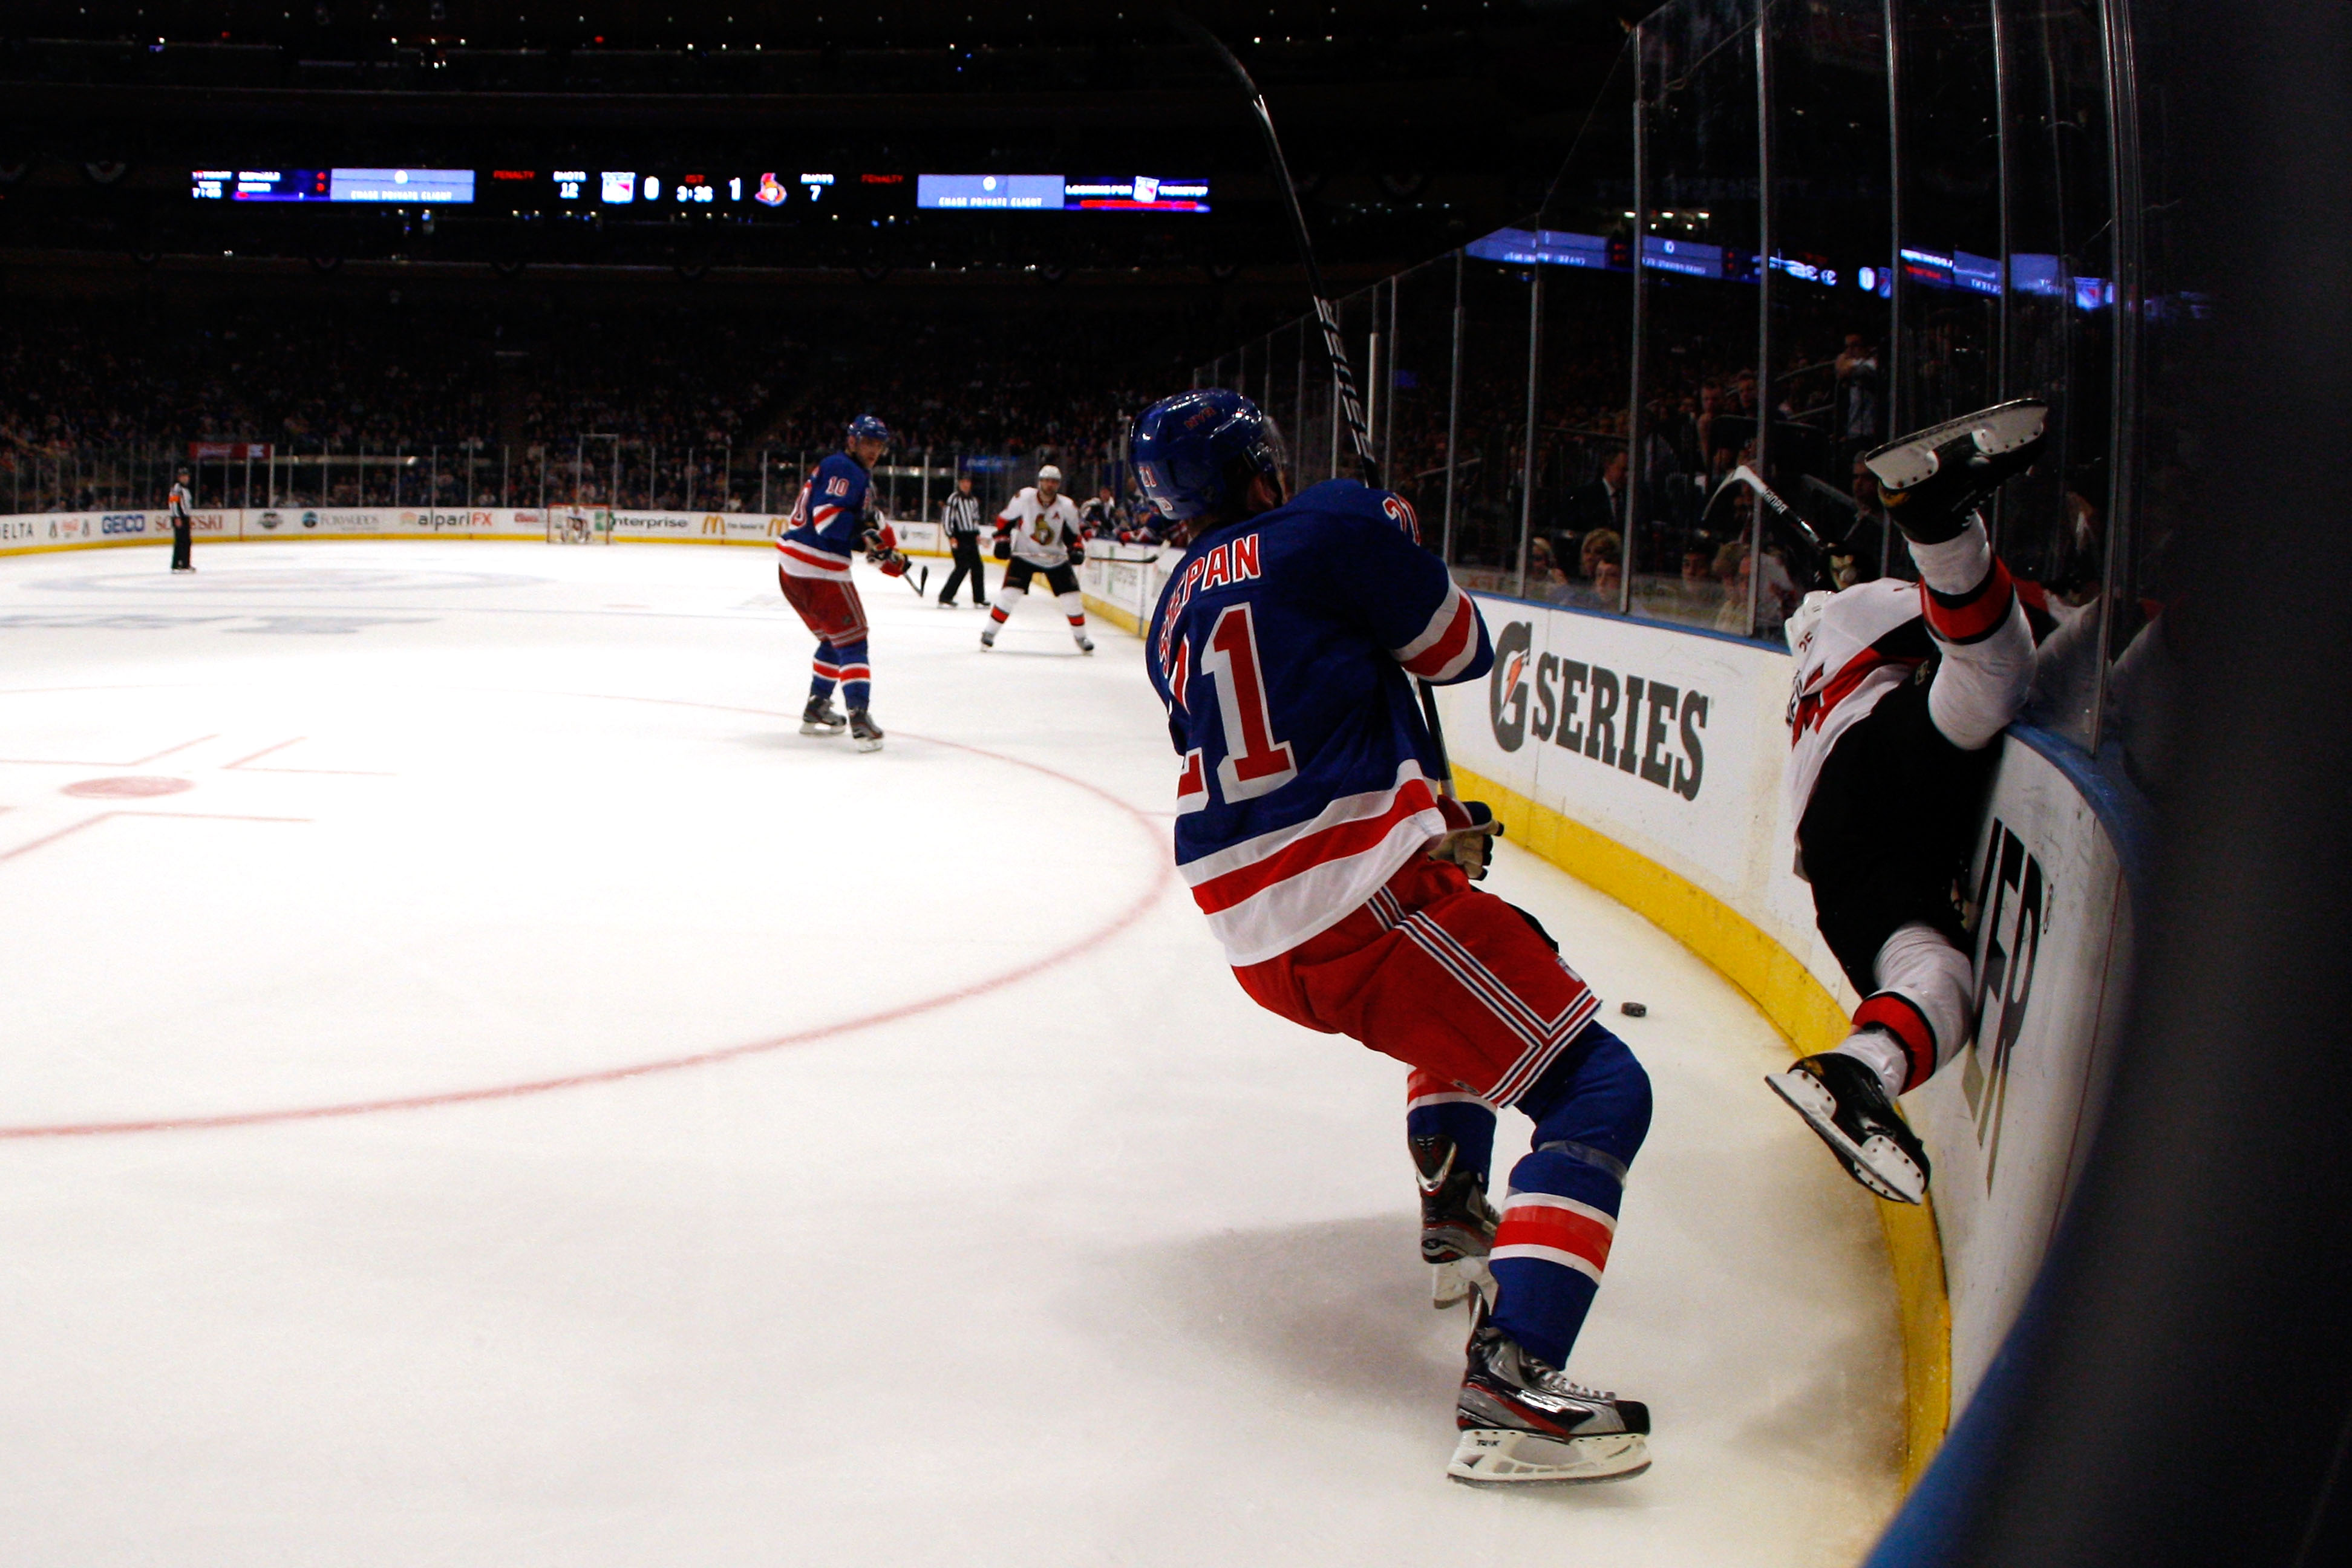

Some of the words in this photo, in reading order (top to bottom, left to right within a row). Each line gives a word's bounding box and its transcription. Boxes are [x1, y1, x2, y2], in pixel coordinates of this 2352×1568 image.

[560, 182, 578, 199] 12
[644, 176, 659, 201] 0
[729, 177, 741, 201] 1
[810, 185, 821, 201] 7
[825, 475, 849, 497] 10
[0, 522, 34, 540] ELTA
[102, 514, 145, 534] GEICO
[417, 508, 492, 532] alpariFX
[1531, 651, 1709, 802] SERIES
